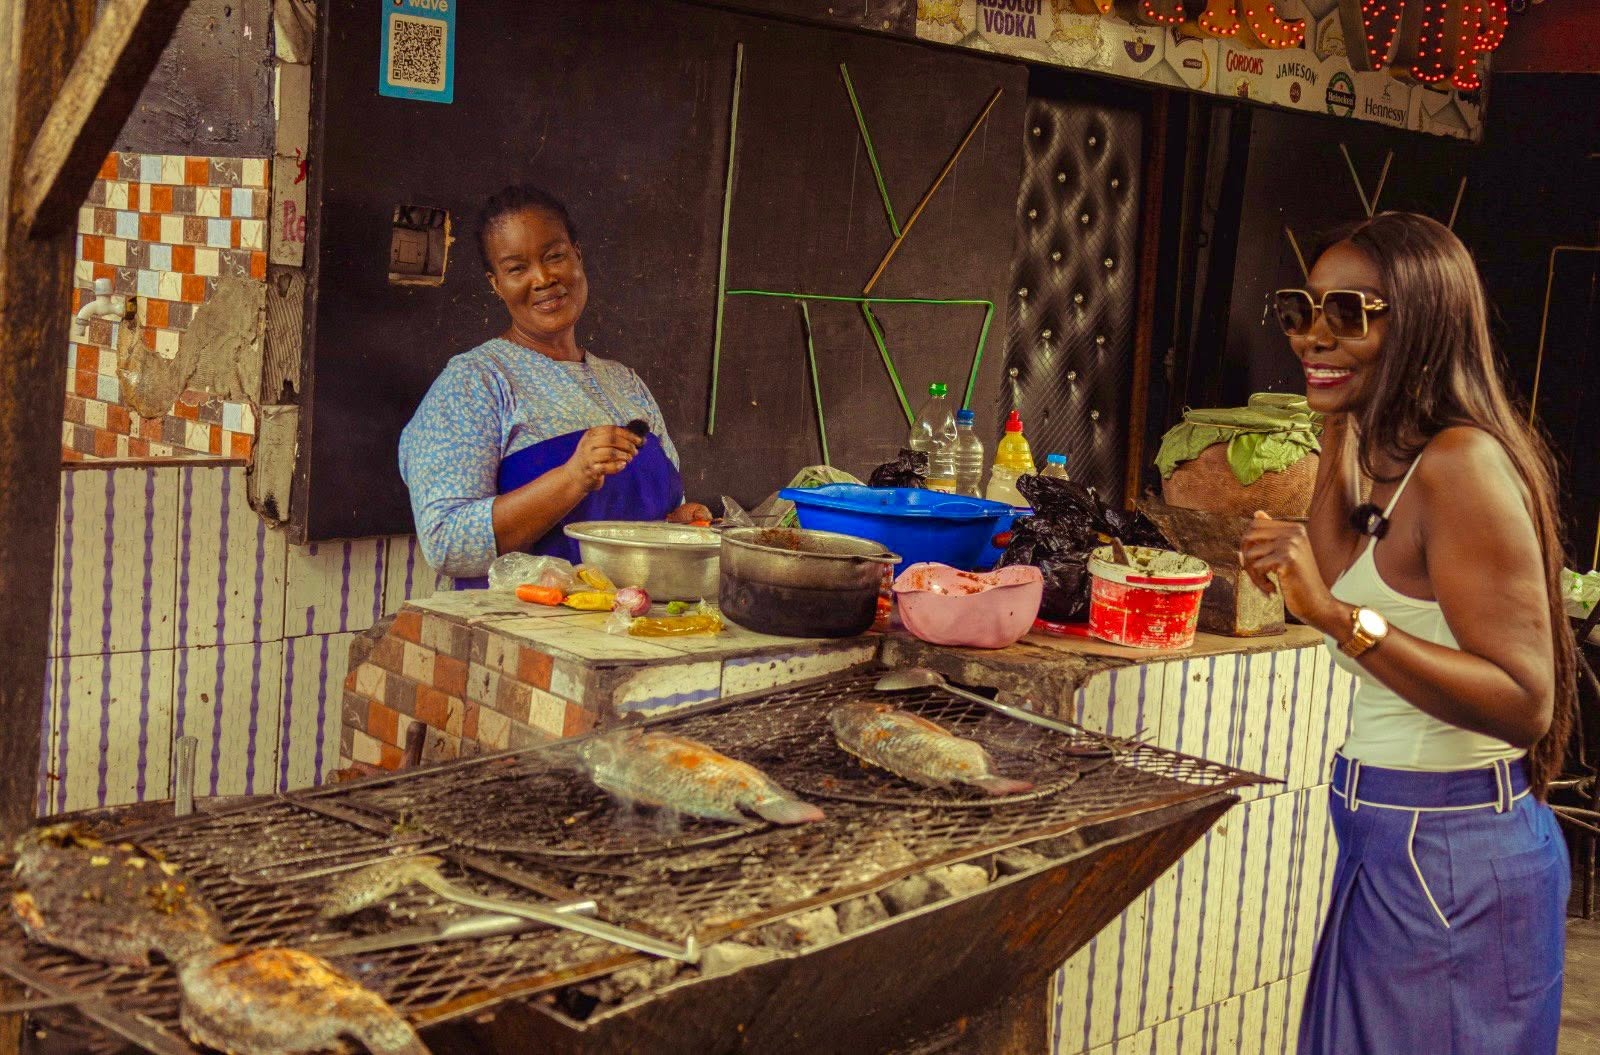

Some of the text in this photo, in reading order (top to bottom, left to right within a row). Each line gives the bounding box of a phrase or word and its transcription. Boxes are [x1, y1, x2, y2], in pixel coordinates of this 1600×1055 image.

[976, 0, 1042, 16] OLUT
[983, 8, 1037, 40] VODKA
[1276, 62, 1319, 86] JAMESON
[1364, 97, 1407, 126] Hennessy
